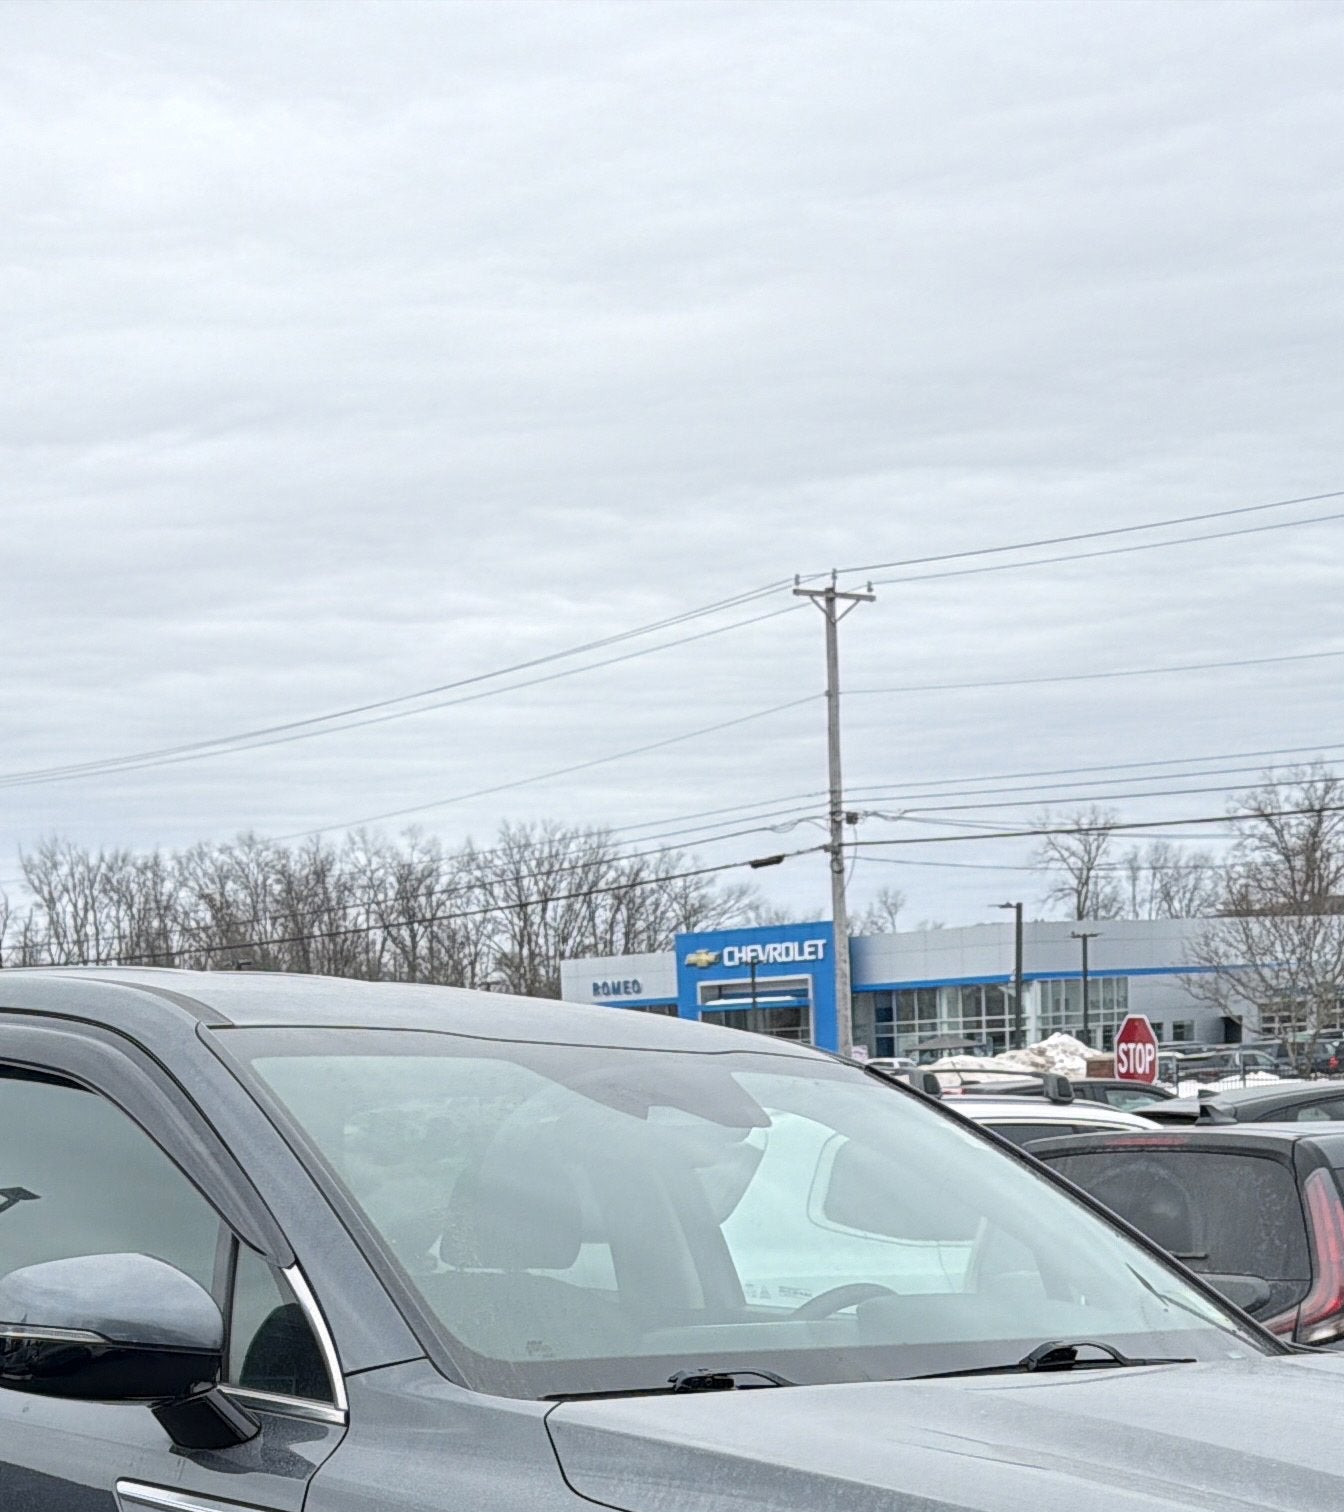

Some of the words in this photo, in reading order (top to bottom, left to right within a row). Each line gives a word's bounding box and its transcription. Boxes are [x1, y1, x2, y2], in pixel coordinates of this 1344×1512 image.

[722, 938, 827, 967] CHEVROLET
[592, 979, 643, 996] ROMEO
[1118, 1042, 1155, 1074] STOP
